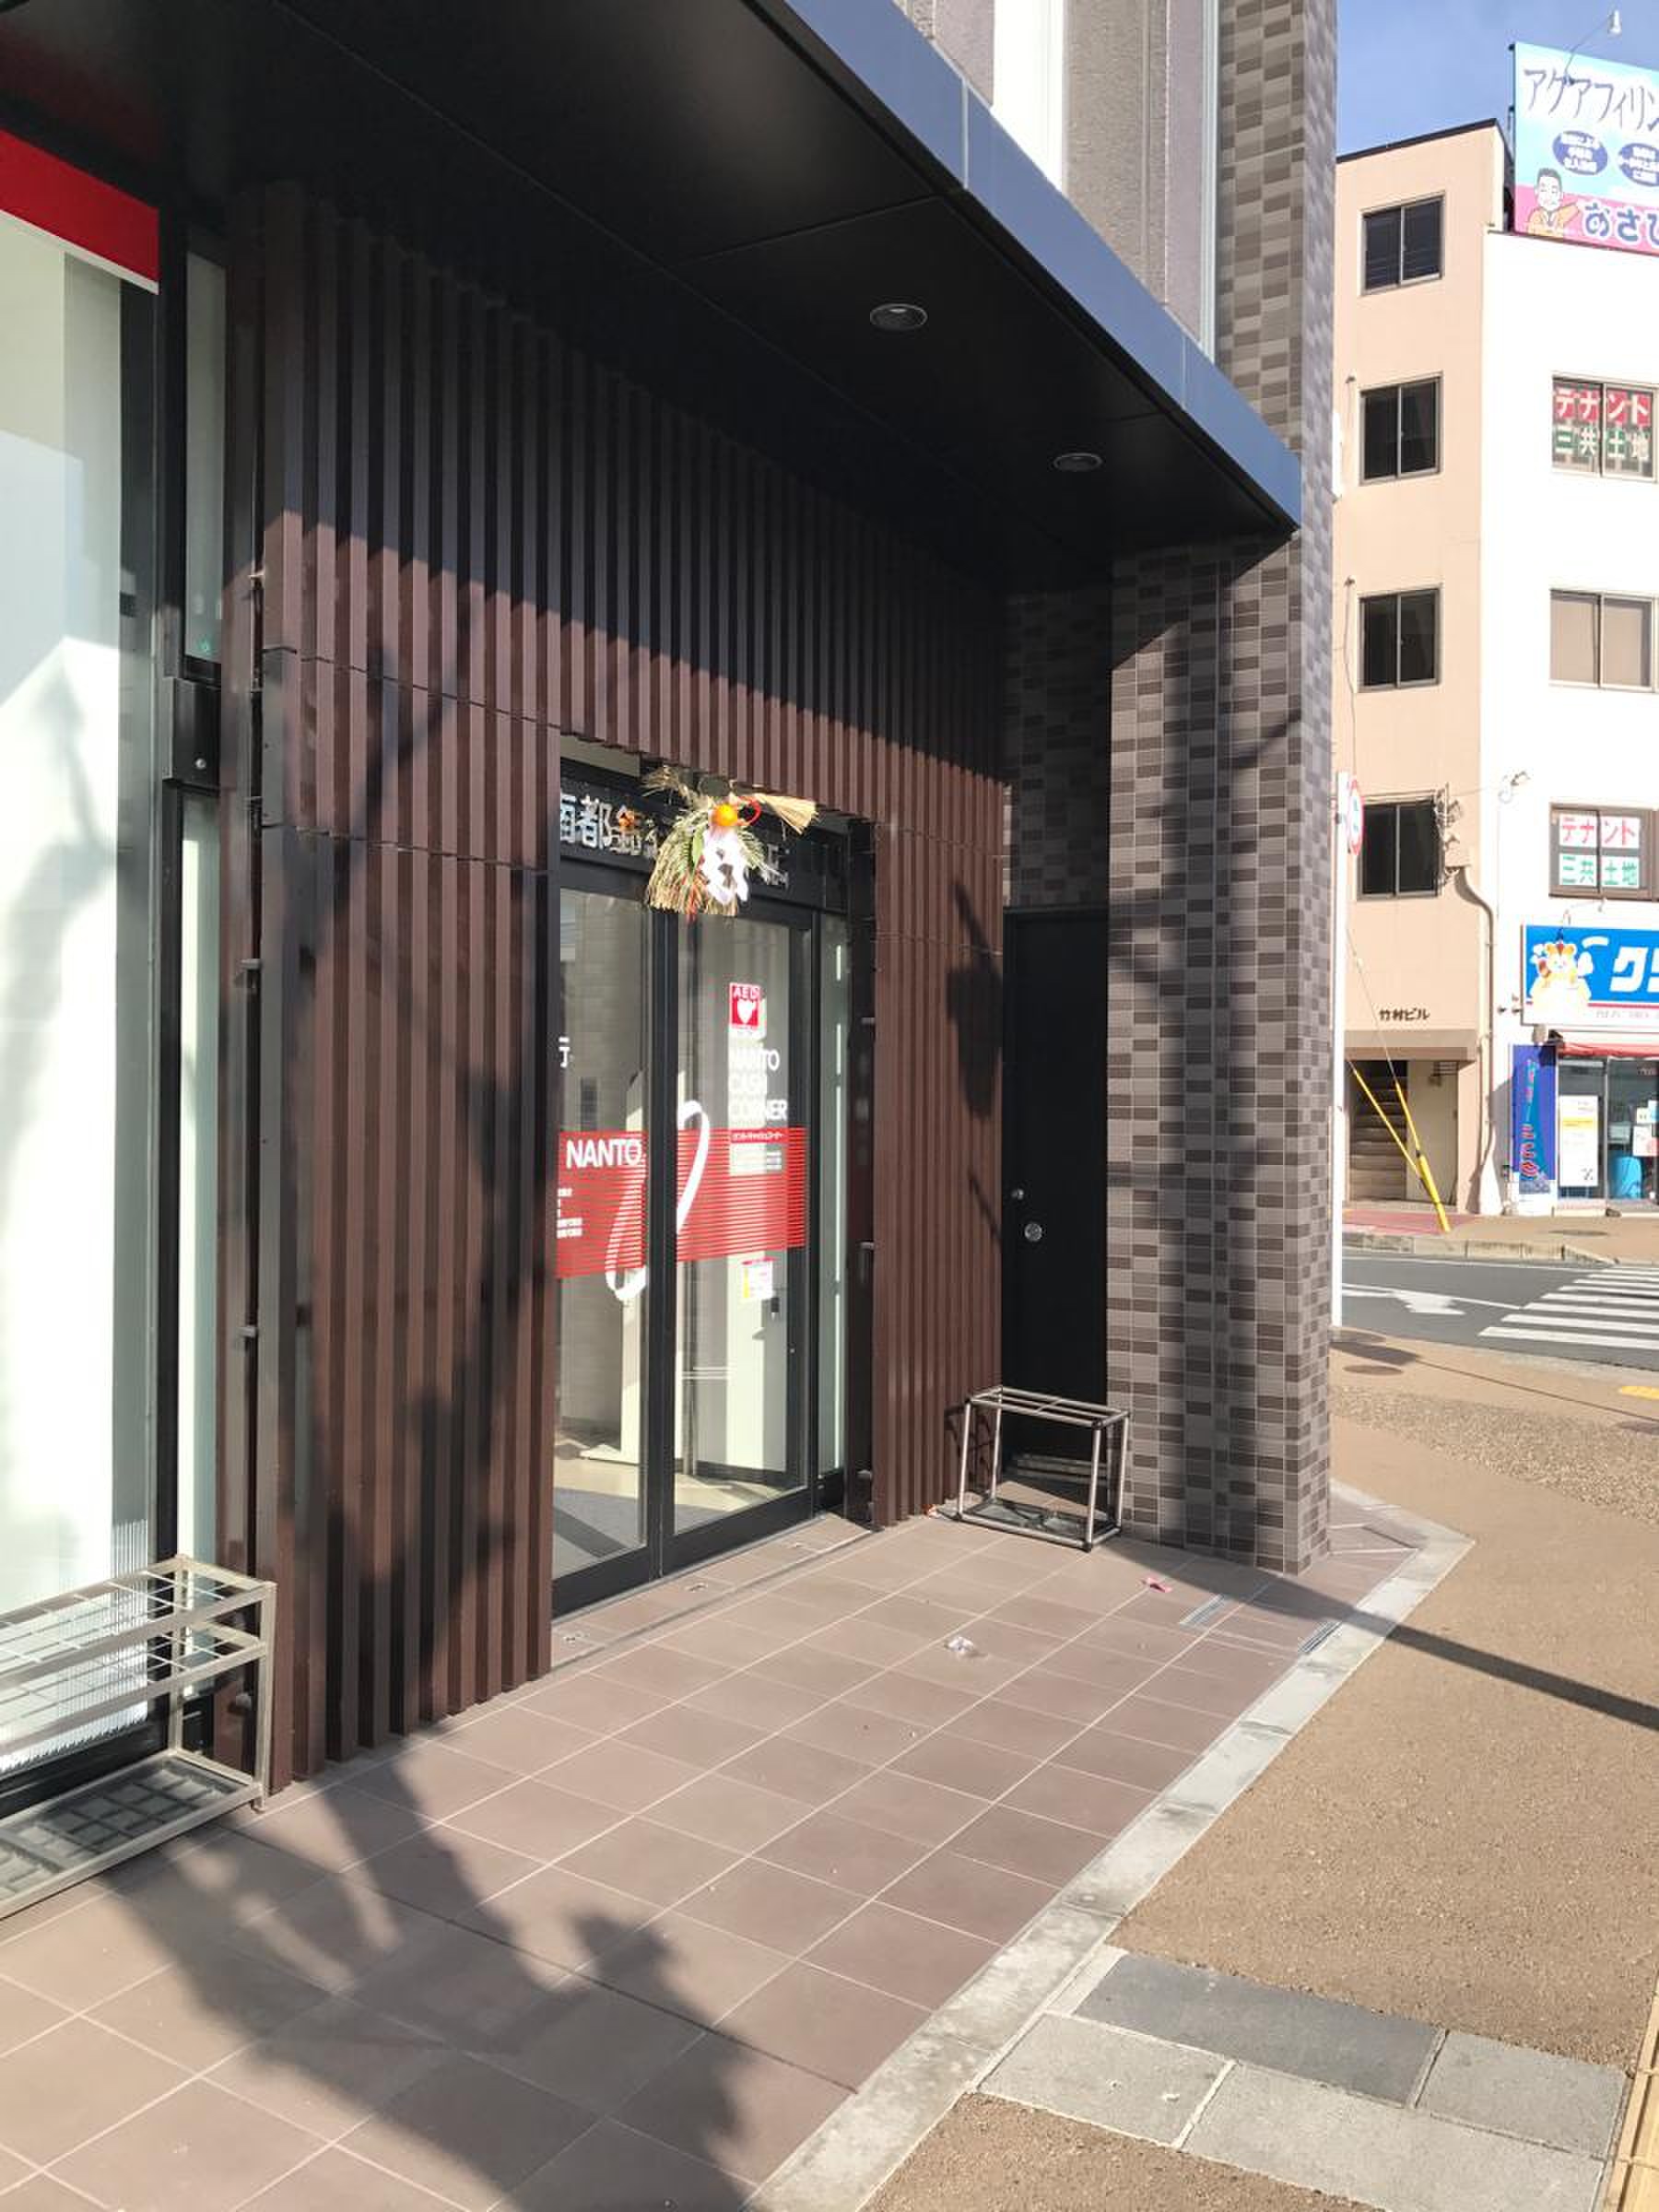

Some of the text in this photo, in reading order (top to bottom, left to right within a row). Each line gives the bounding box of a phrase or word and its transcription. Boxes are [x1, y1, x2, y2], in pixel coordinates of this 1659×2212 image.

[1555, 387, 1650, 426] テナント
[1555, 424, 1651, 460] 三共土地
[1562, 816, 1636, 846] テナント
[1561, 854, 1638, 886] 三共土地
[733, 986, 761, 1000] AED
[566, 1138, 642, 1169] NANTO
